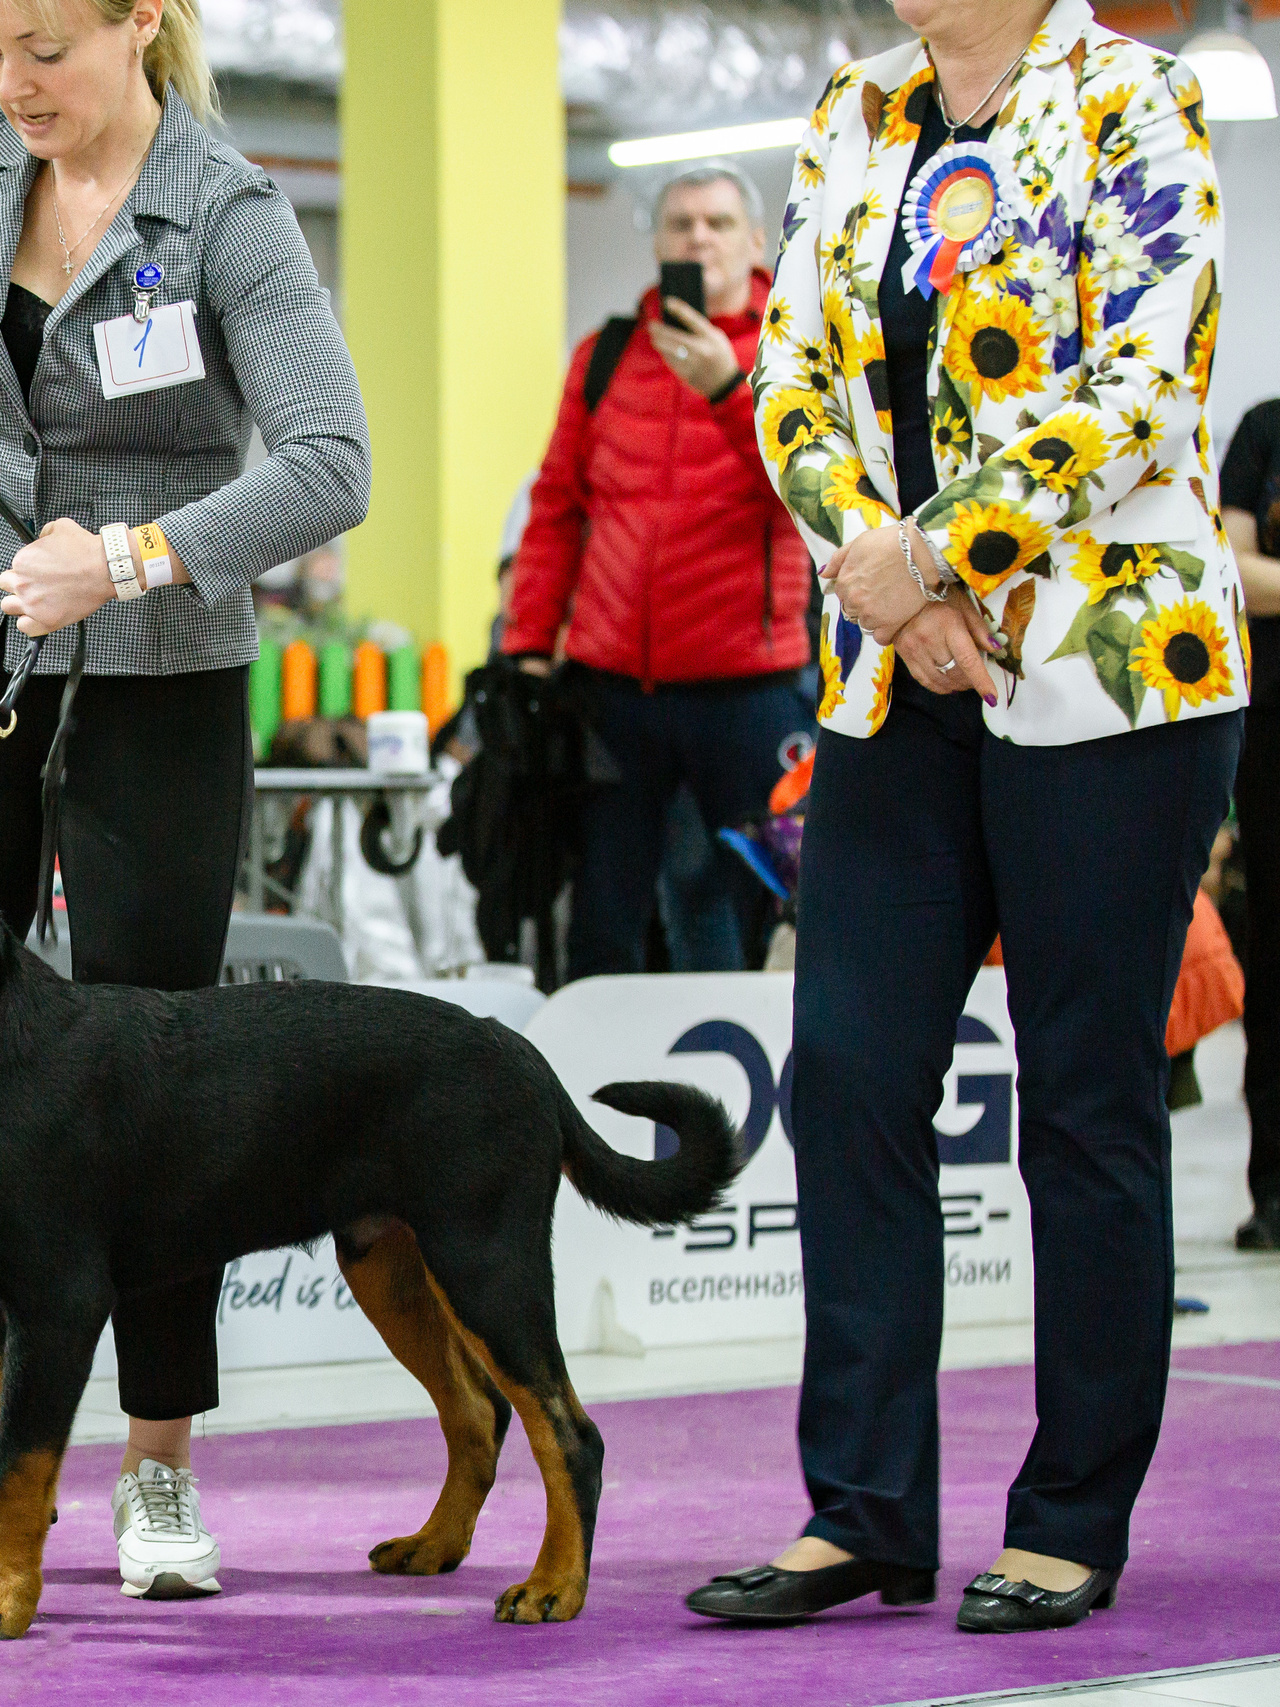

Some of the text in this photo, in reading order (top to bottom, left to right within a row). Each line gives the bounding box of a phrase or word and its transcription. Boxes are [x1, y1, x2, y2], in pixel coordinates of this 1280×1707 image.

[654, 1015, 1014, 1168] DG
[652, 1193, 1011, 1253] -SPE-
[296, 1273, 325, 1309] is
[649, 1251, 1012, 1305] вселенная баки
